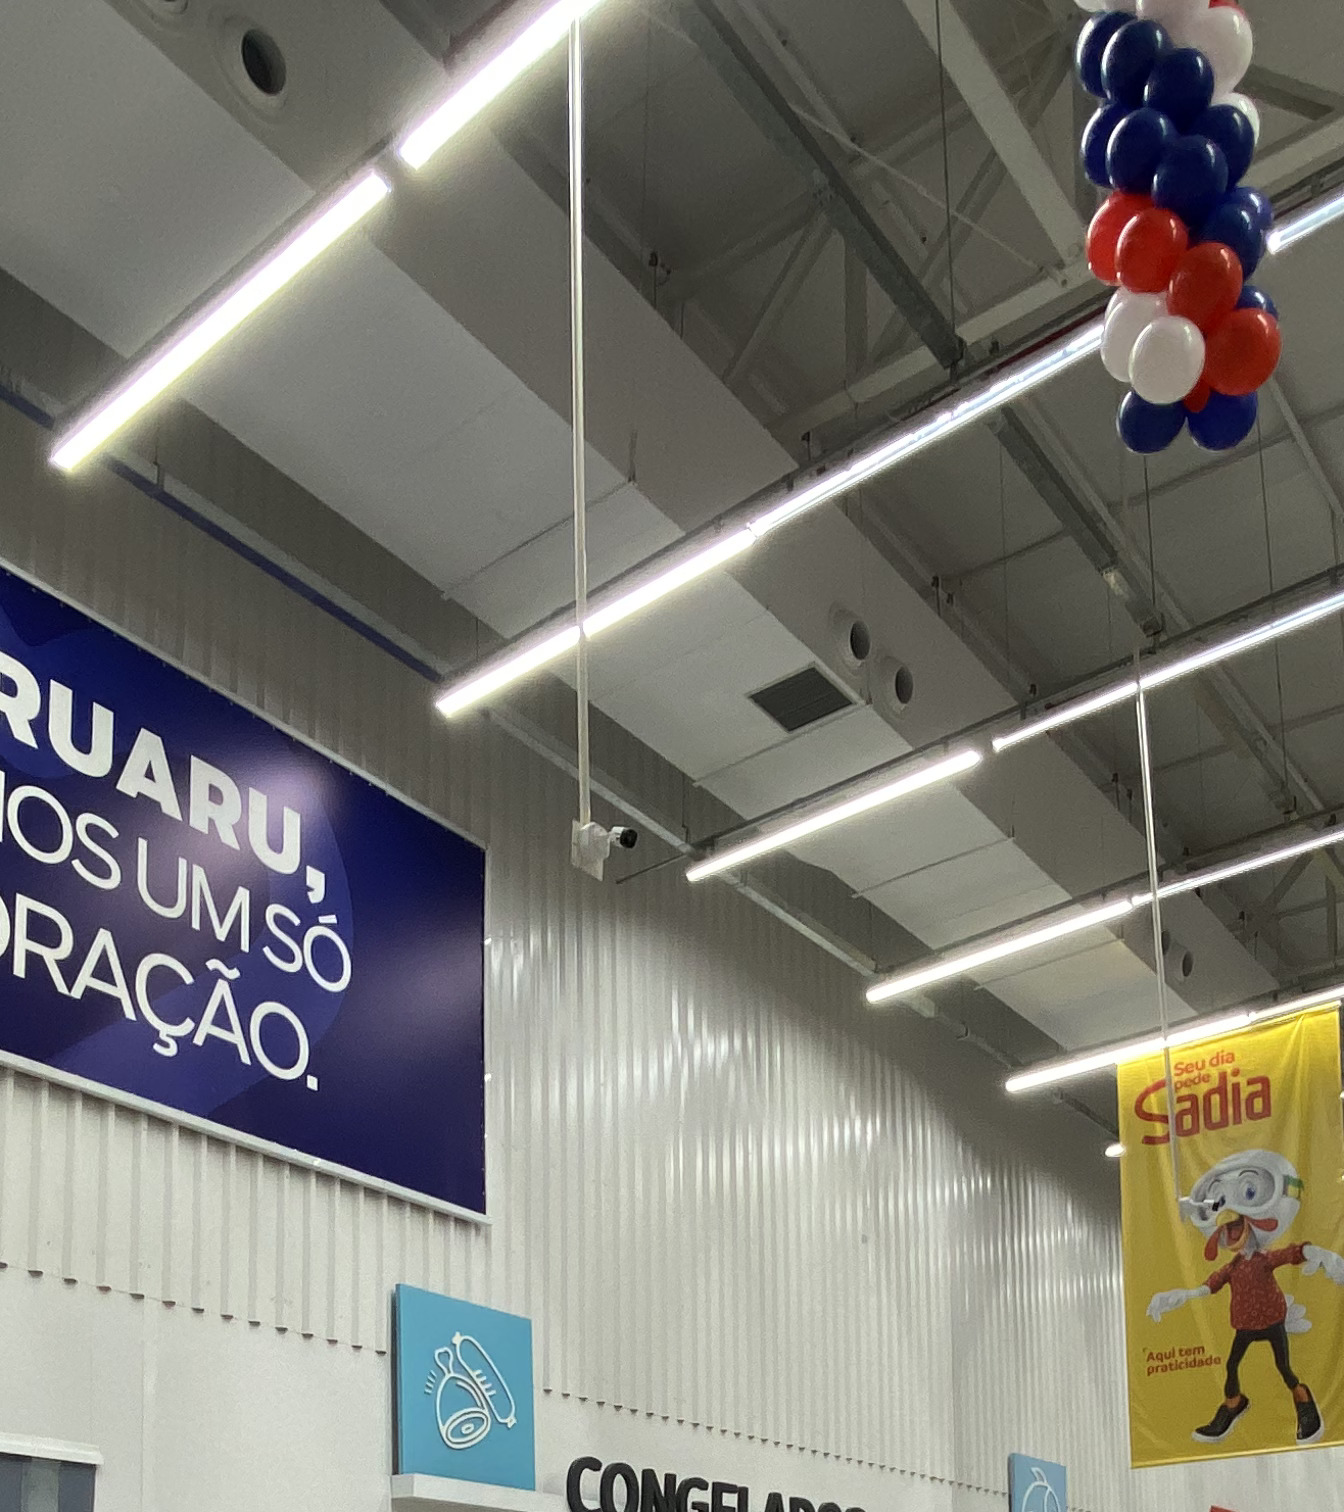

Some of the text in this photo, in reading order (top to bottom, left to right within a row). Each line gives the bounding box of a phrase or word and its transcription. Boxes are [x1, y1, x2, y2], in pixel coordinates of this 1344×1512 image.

[138, 838, 252, 952] UM
[264, 904, 352, 993] SÓ
[1173, 1050, 1236, 1077] Seu dia
[1174, 1072, 1212, 1093] pede
[1134, 1067, 1272, 1146] Sadia
[1146, 1346, 1205, 1363] Aqui tem
[1147, 1355, 1221, 1377] praticidade
